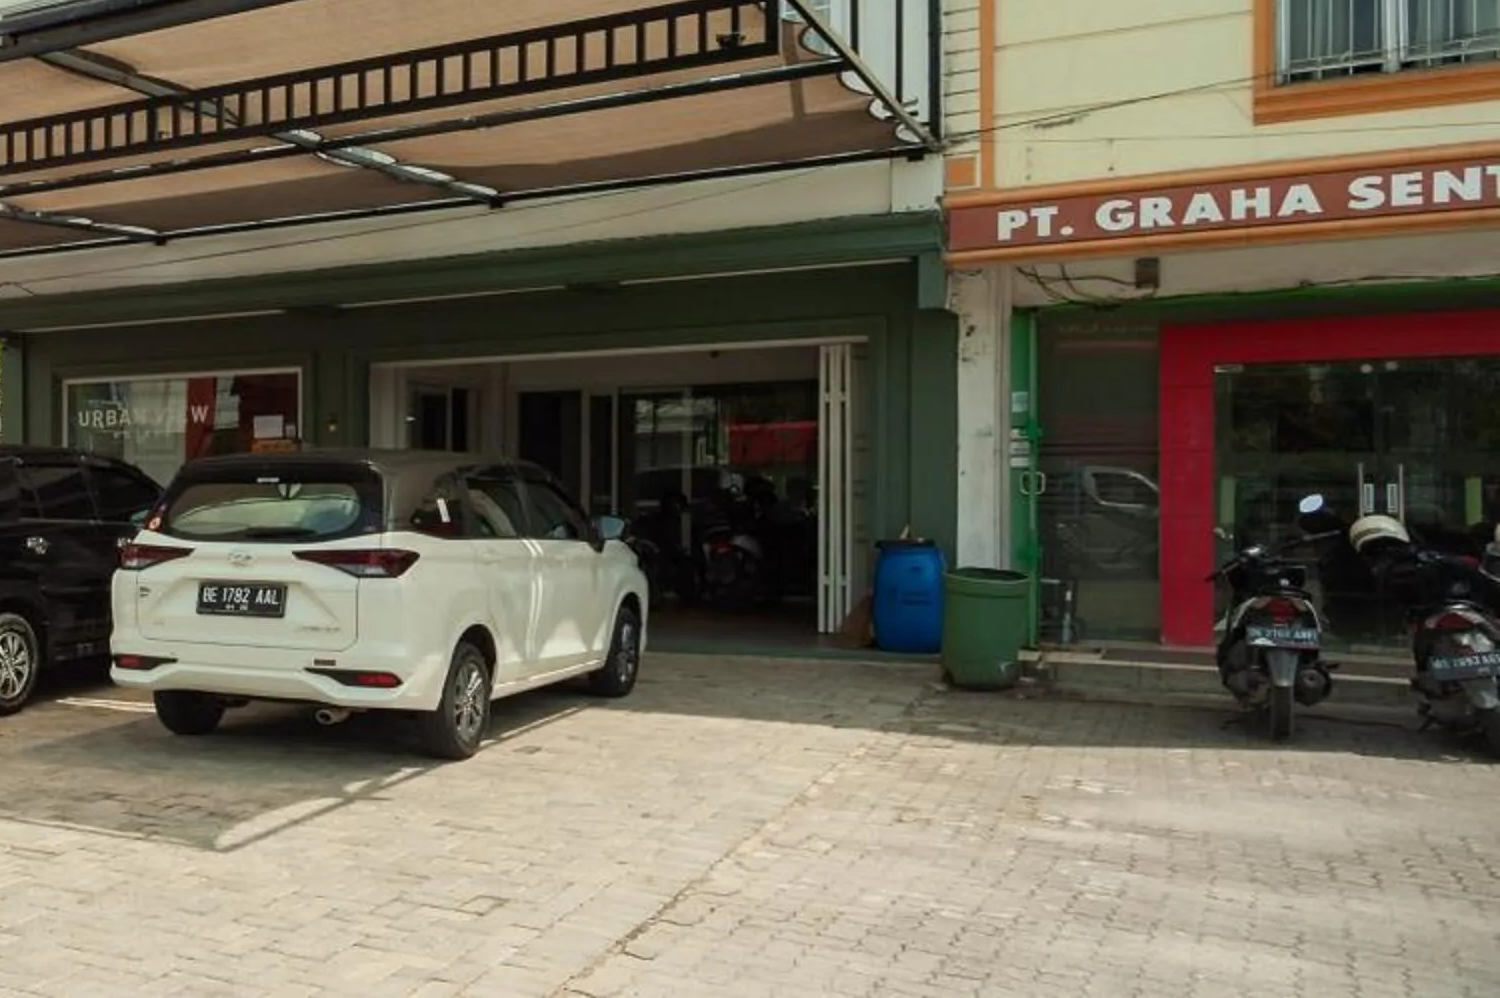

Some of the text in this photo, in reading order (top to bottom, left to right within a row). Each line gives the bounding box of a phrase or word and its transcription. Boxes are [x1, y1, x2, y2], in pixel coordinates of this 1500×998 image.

[997, 205, 1074, 242] PT.
[1094, 182, 1325, 232] GRAHA
[254, 589, 279, 605] AAL
